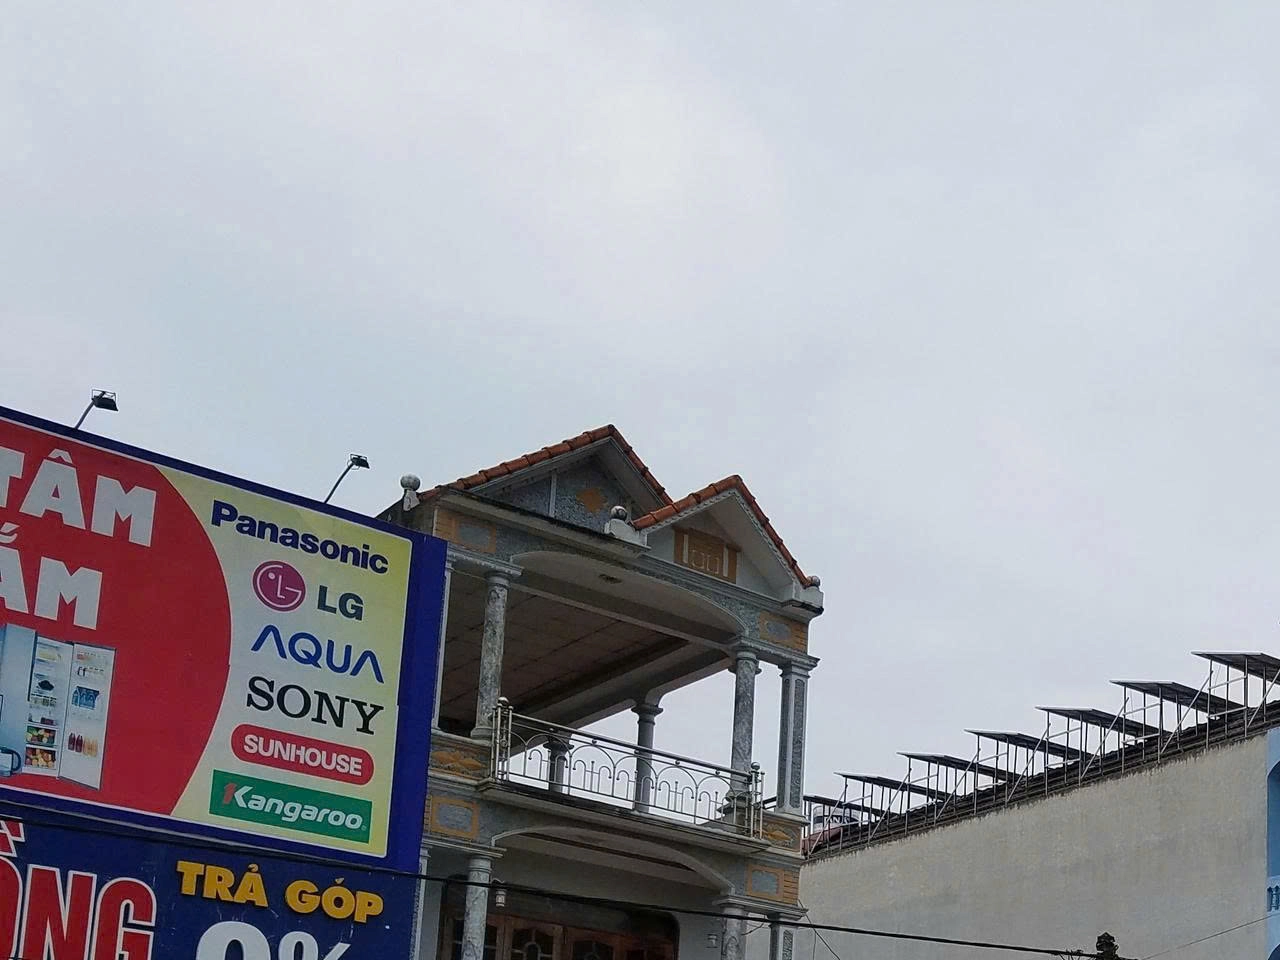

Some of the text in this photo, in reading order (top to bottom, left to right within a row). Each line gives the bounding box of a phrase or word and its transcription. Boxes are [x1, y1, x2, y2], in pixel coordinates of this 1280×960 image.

[211, 500, 388, 574] Panasonic
[317, 585, 364, 621] LG
[251, 624, 384, 683] AQUA
[247, 676, 383, 735] SONY
[244, 734, 363, 776] SUNHOUSE
[223, 782, 365, 830] Kangaroo
[177, 860, 383, 923] TRẢ GÓP
